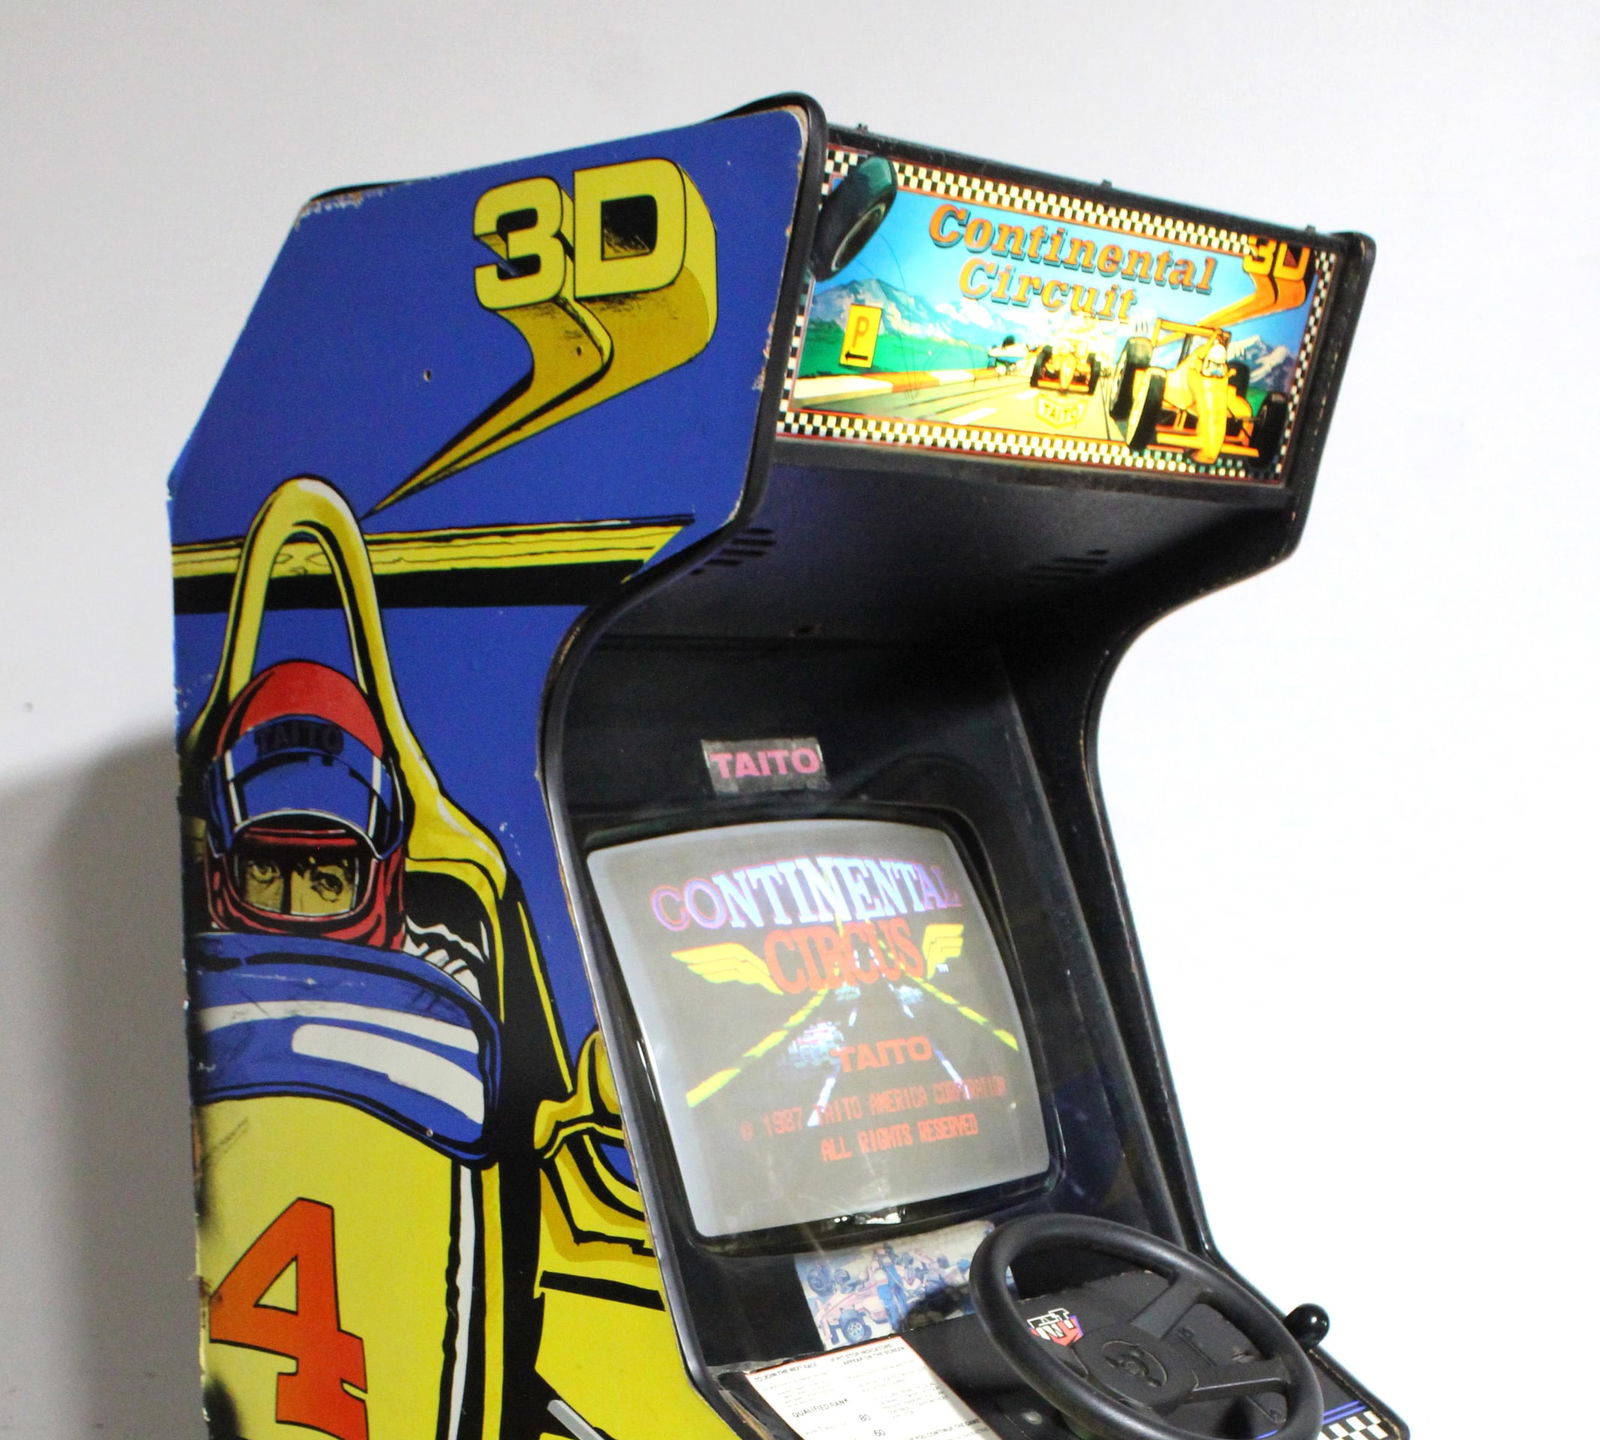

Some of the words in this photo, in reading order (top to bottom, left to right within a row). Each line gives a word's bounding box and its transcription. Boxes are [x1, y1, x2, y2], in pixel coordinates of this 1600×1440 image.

[474, 157, 690, 310] 3D
[929, 203, 1217, 295] Continental
[959, 256, 1138, 324] Circuit
[850, 316, 870, 348] P
[1043, 401, 1081, 423] TAITO
[254, 719, 344, 759] TAITO
[709, 748, 821, 780] TAITO
[651, 854, 962, 931] CONTINENTAL
[764, 917, 927, 994] CIRCUS
[838, 1035, 933, 1073] TAITO
[763, 1107, 804, 1136] 1987
[869, 1085, 928, 1115] AMERICA
[821, 1136, 852, 1162] ALL
[857, 1123, 912, 1154] RIGHTS
[917, 1113, 979, 1143] RESERVED
[792, 1403, 829, 1418] QUALIFIED
